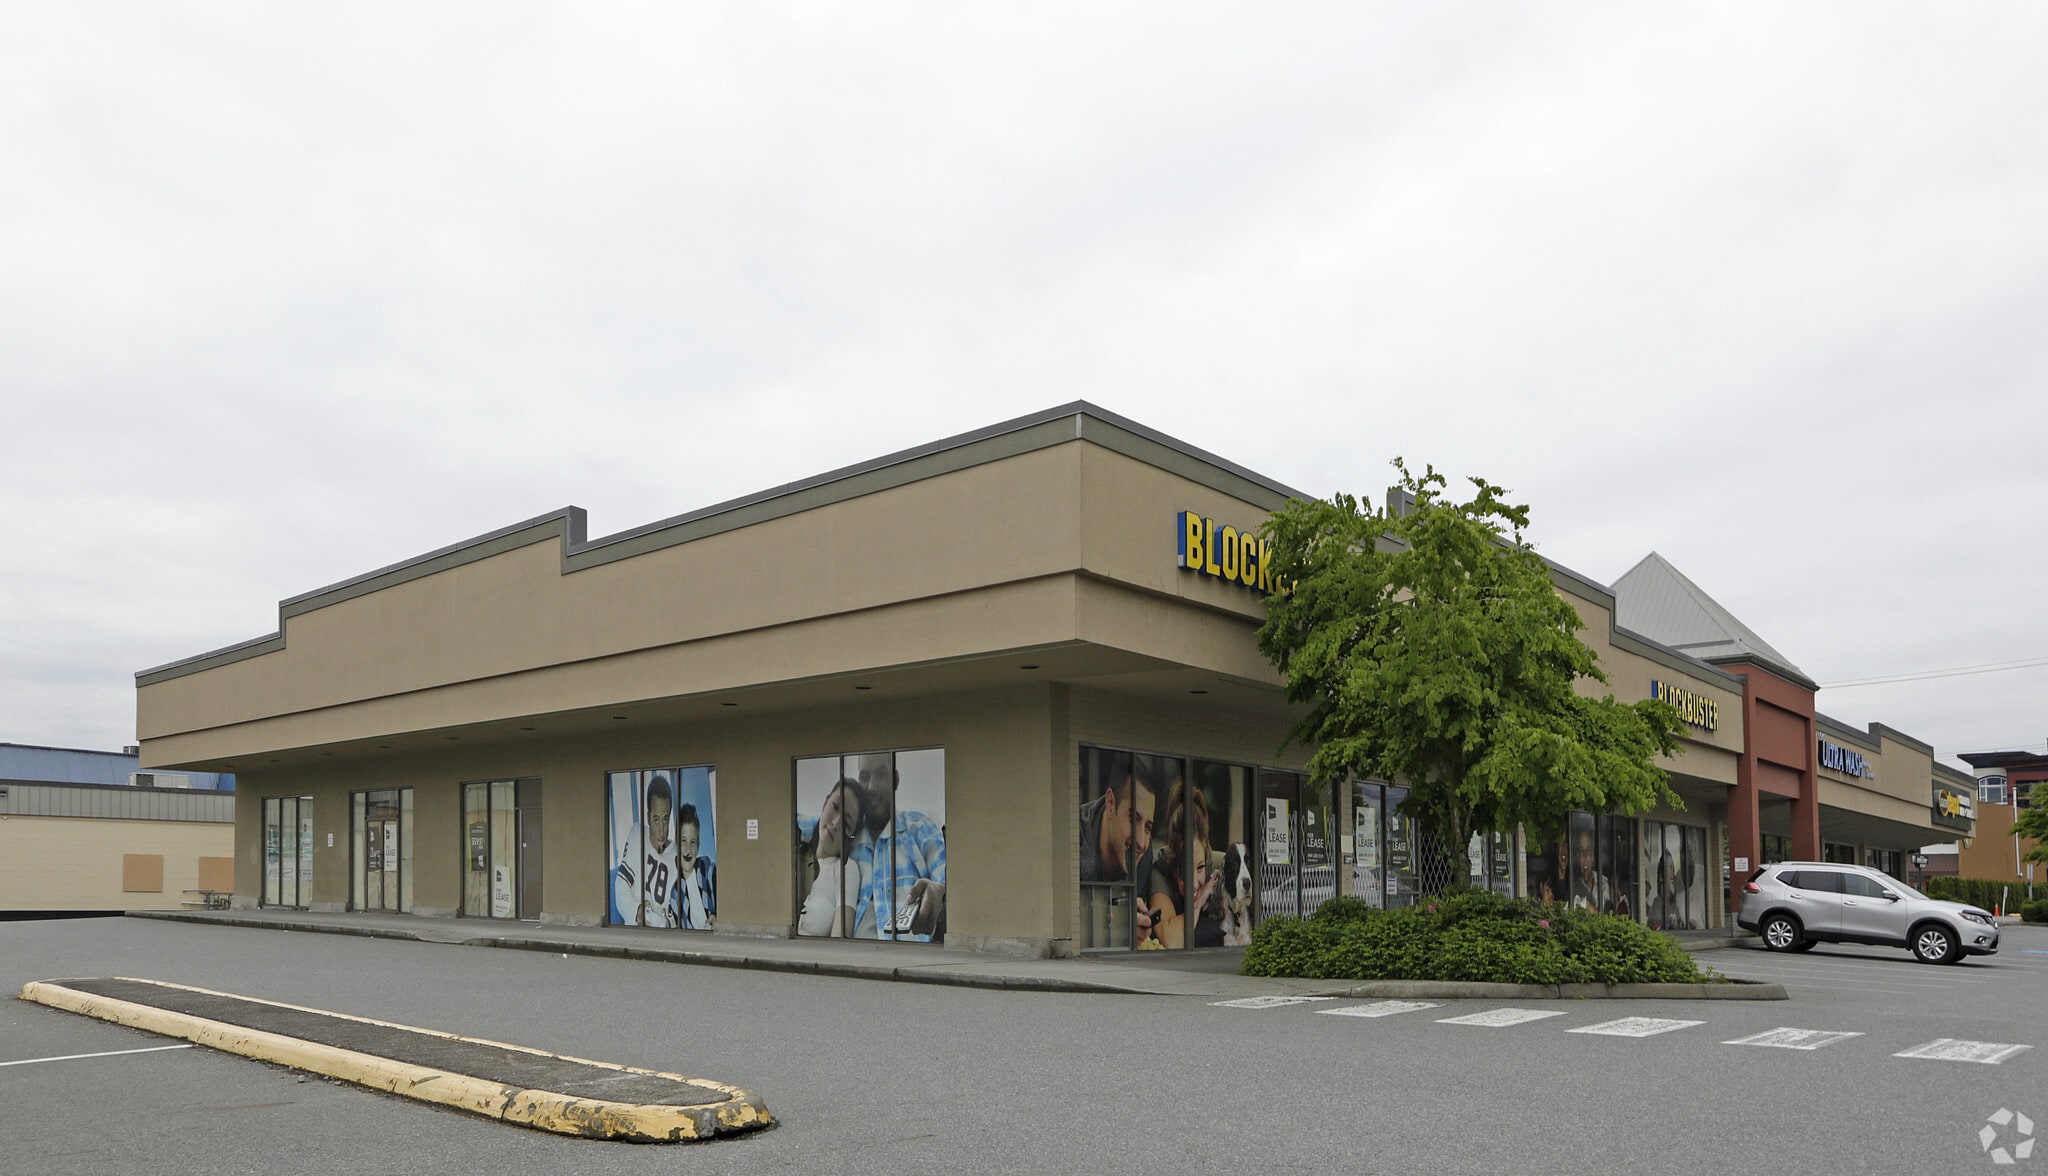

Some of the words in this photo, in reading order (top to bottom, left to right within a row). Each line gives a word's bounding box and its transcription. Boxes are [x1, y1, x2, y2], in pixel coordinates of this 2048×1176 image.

[1845, 748, 1864, 777] WASH
[1268, 832, 1287, 843] LEASE
[1358, 838, 1374, 848] LEASE
[1307, 838, 1324, 849] LEASE
[1392, 842, 1407, 852] LEASE
[646, 854, 669, 905] 78
[496, 892, 510, 902] LEASE
